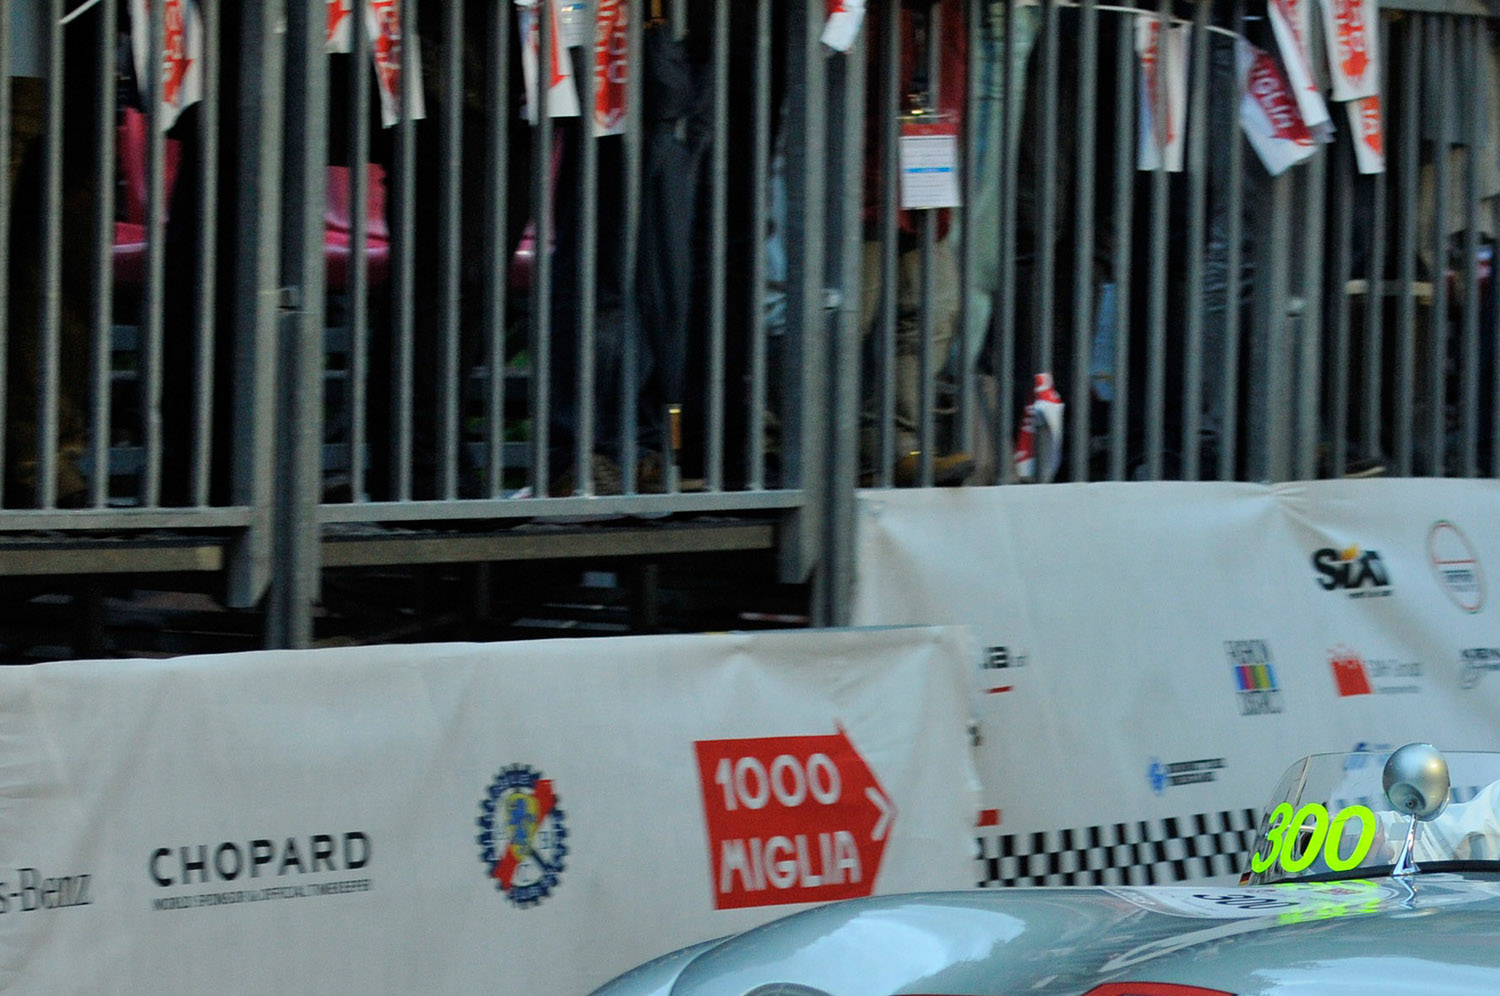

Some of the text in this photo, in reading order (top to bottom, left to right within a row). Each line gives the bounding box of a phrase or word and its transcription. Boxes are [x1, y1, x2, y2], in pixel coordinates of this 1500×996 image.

[714, 752, 843, 812] 1000
[150, 831, 371, 887] CHOPARD
[719, 830, 863, 894] MIGLIA
[1251, 802, 1376, 874] 300
[1192, 893, 1301, 911] 300
